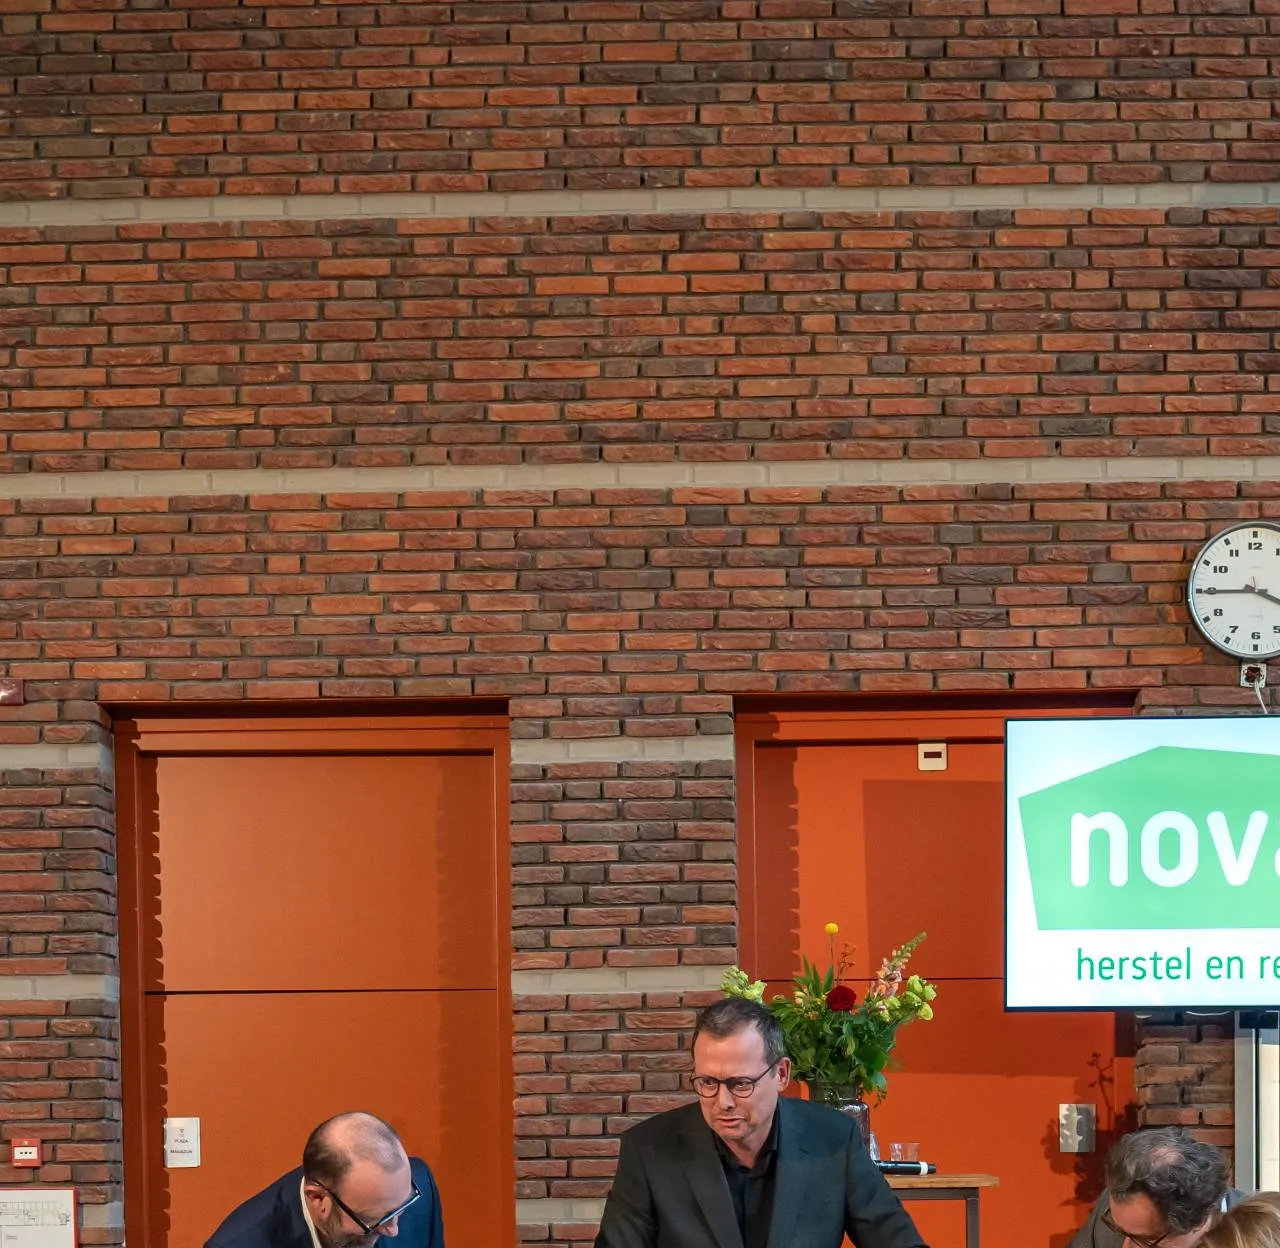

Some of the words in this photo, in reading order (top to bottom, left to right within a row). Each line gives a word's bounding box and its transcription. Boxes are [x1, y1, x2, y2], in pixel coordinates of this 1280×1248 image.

[1248, 542, 1263, 551] 12
[1229, 549, 1239, 557] 11
[1213, 565, 1228, 574] 10
[1213, 608, 1223, 616] 8
[1229, 625, 1239, 634] 7
[1251, 632, 1261, 640] 6
[1077, 947, 1191, 980] herstel
[1206, 955, 1244, 980] en
